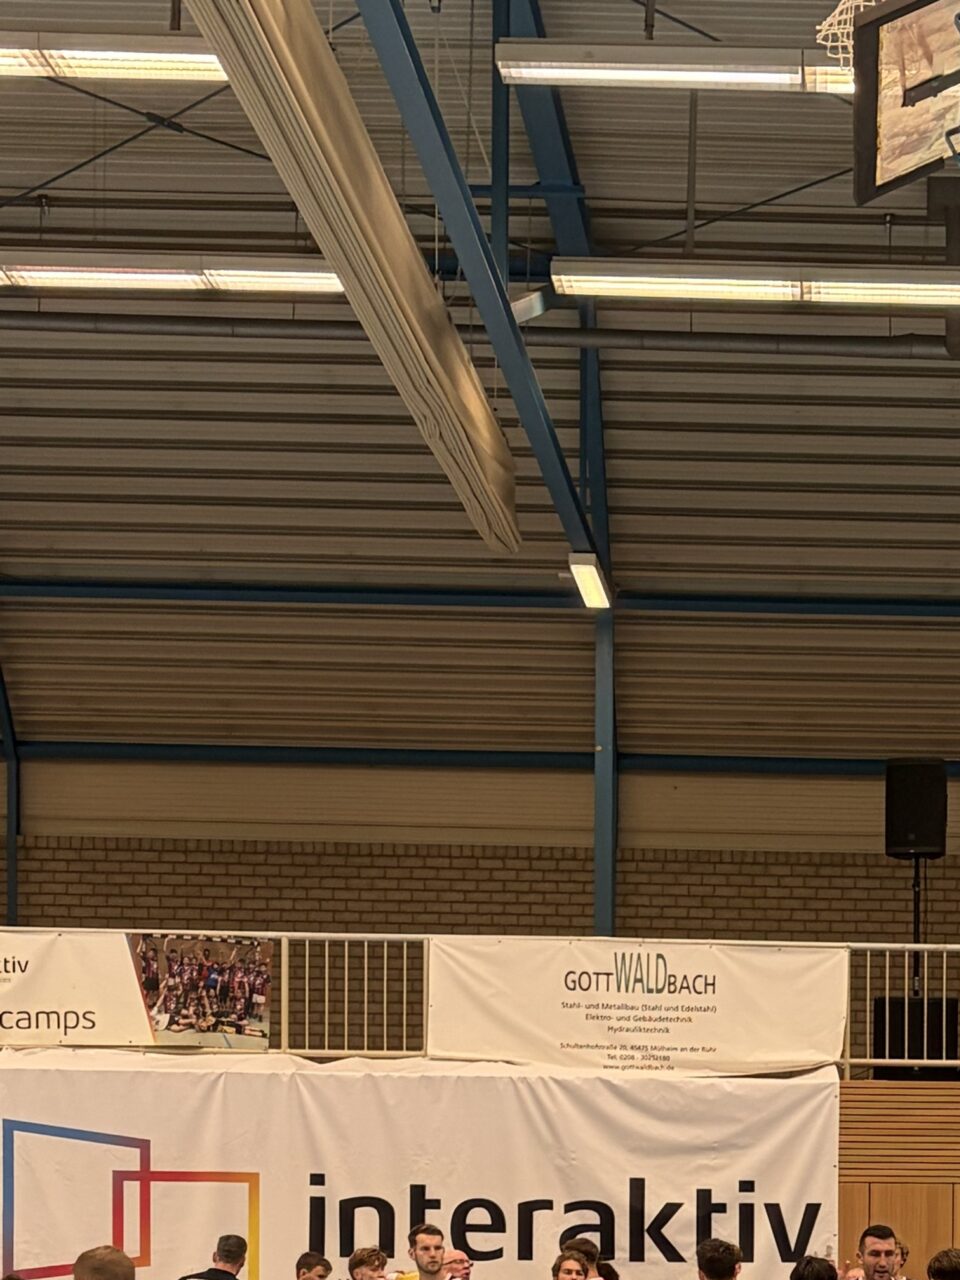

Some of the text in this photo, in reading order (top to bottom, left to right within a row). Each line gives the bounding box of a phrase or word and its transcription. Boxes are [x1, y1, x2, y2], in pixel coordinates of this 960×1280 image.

[0, 956, 29, 973] tiv
[564, 952, 716, 995] GOTTWALDBACH
[308, 1172, 822, 1264] interaktiv
